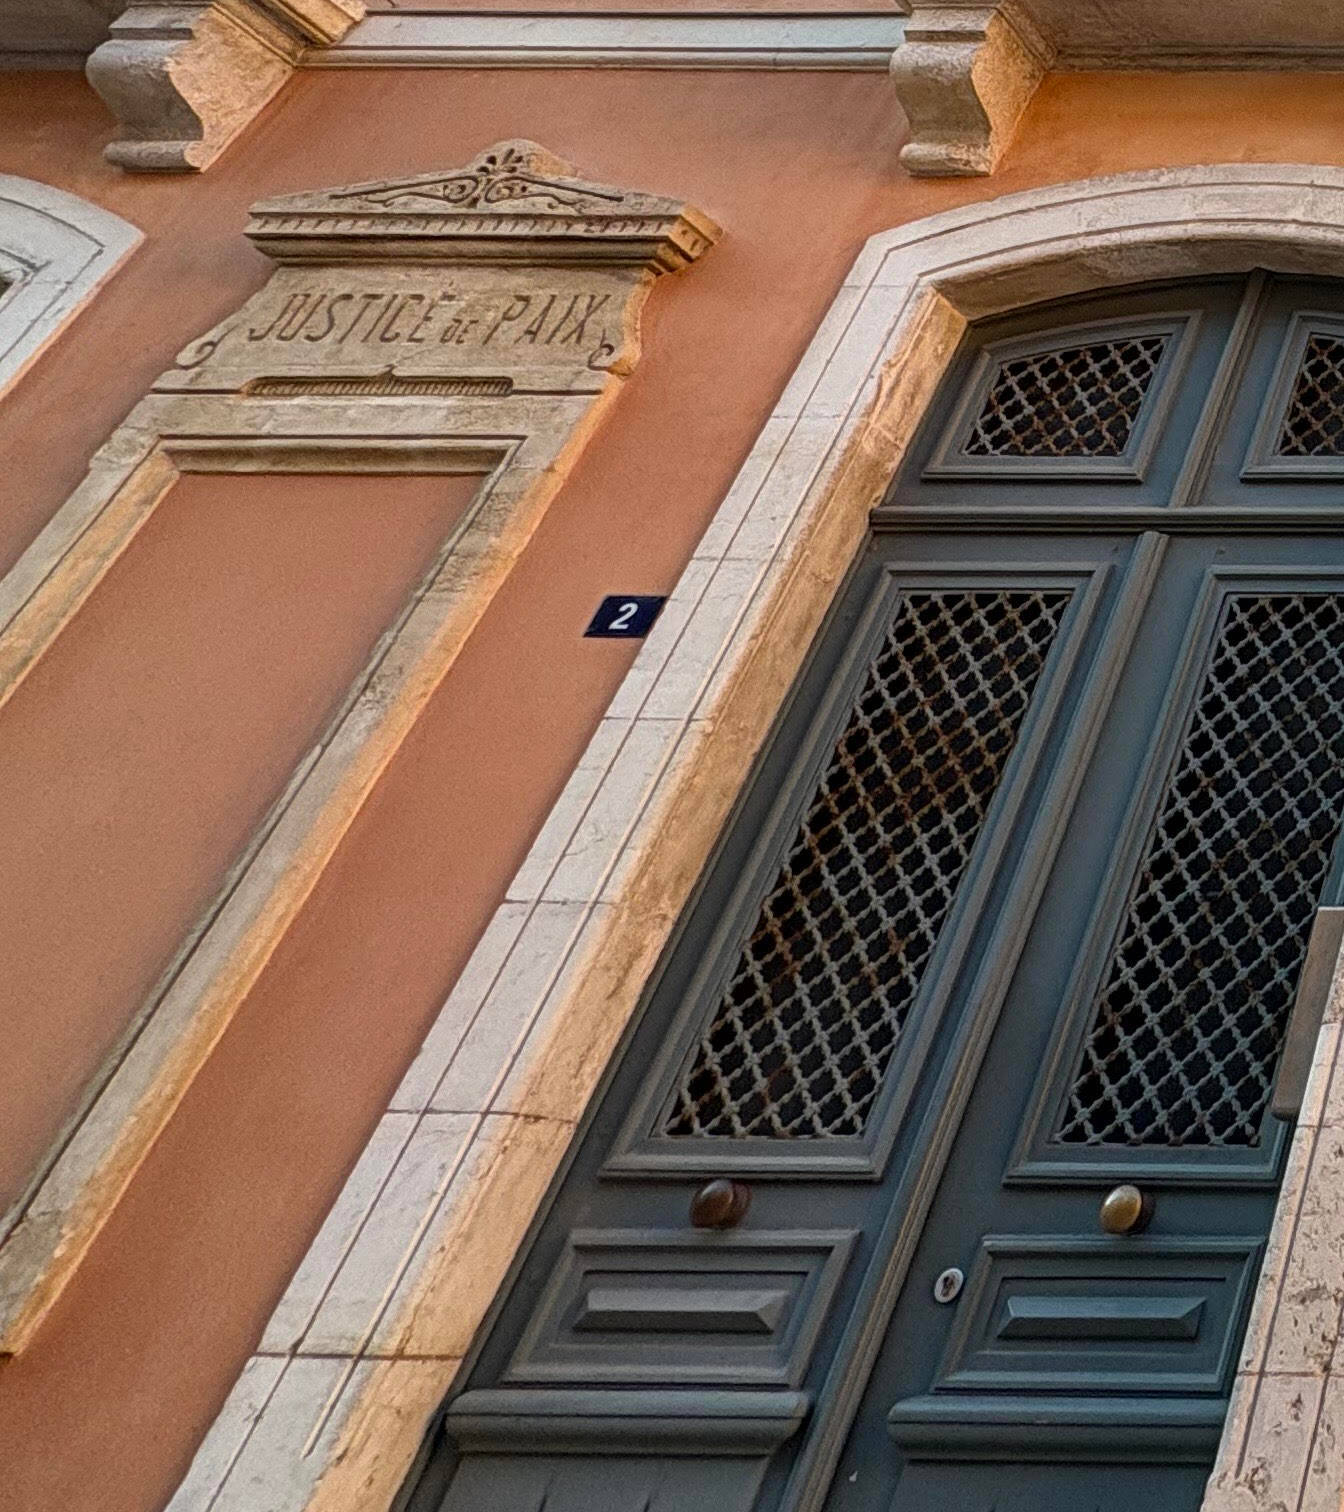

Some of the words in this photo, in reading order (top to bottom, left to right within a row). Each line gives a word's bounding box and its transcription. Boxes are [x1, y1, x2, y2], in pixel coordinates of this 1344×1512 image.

[247, 292, 452, 344] JUSTICE
[440, 318, 475, 346] DE
[482, 293, 611, 346] PAIX
[607, 602, 639, 630] 2
